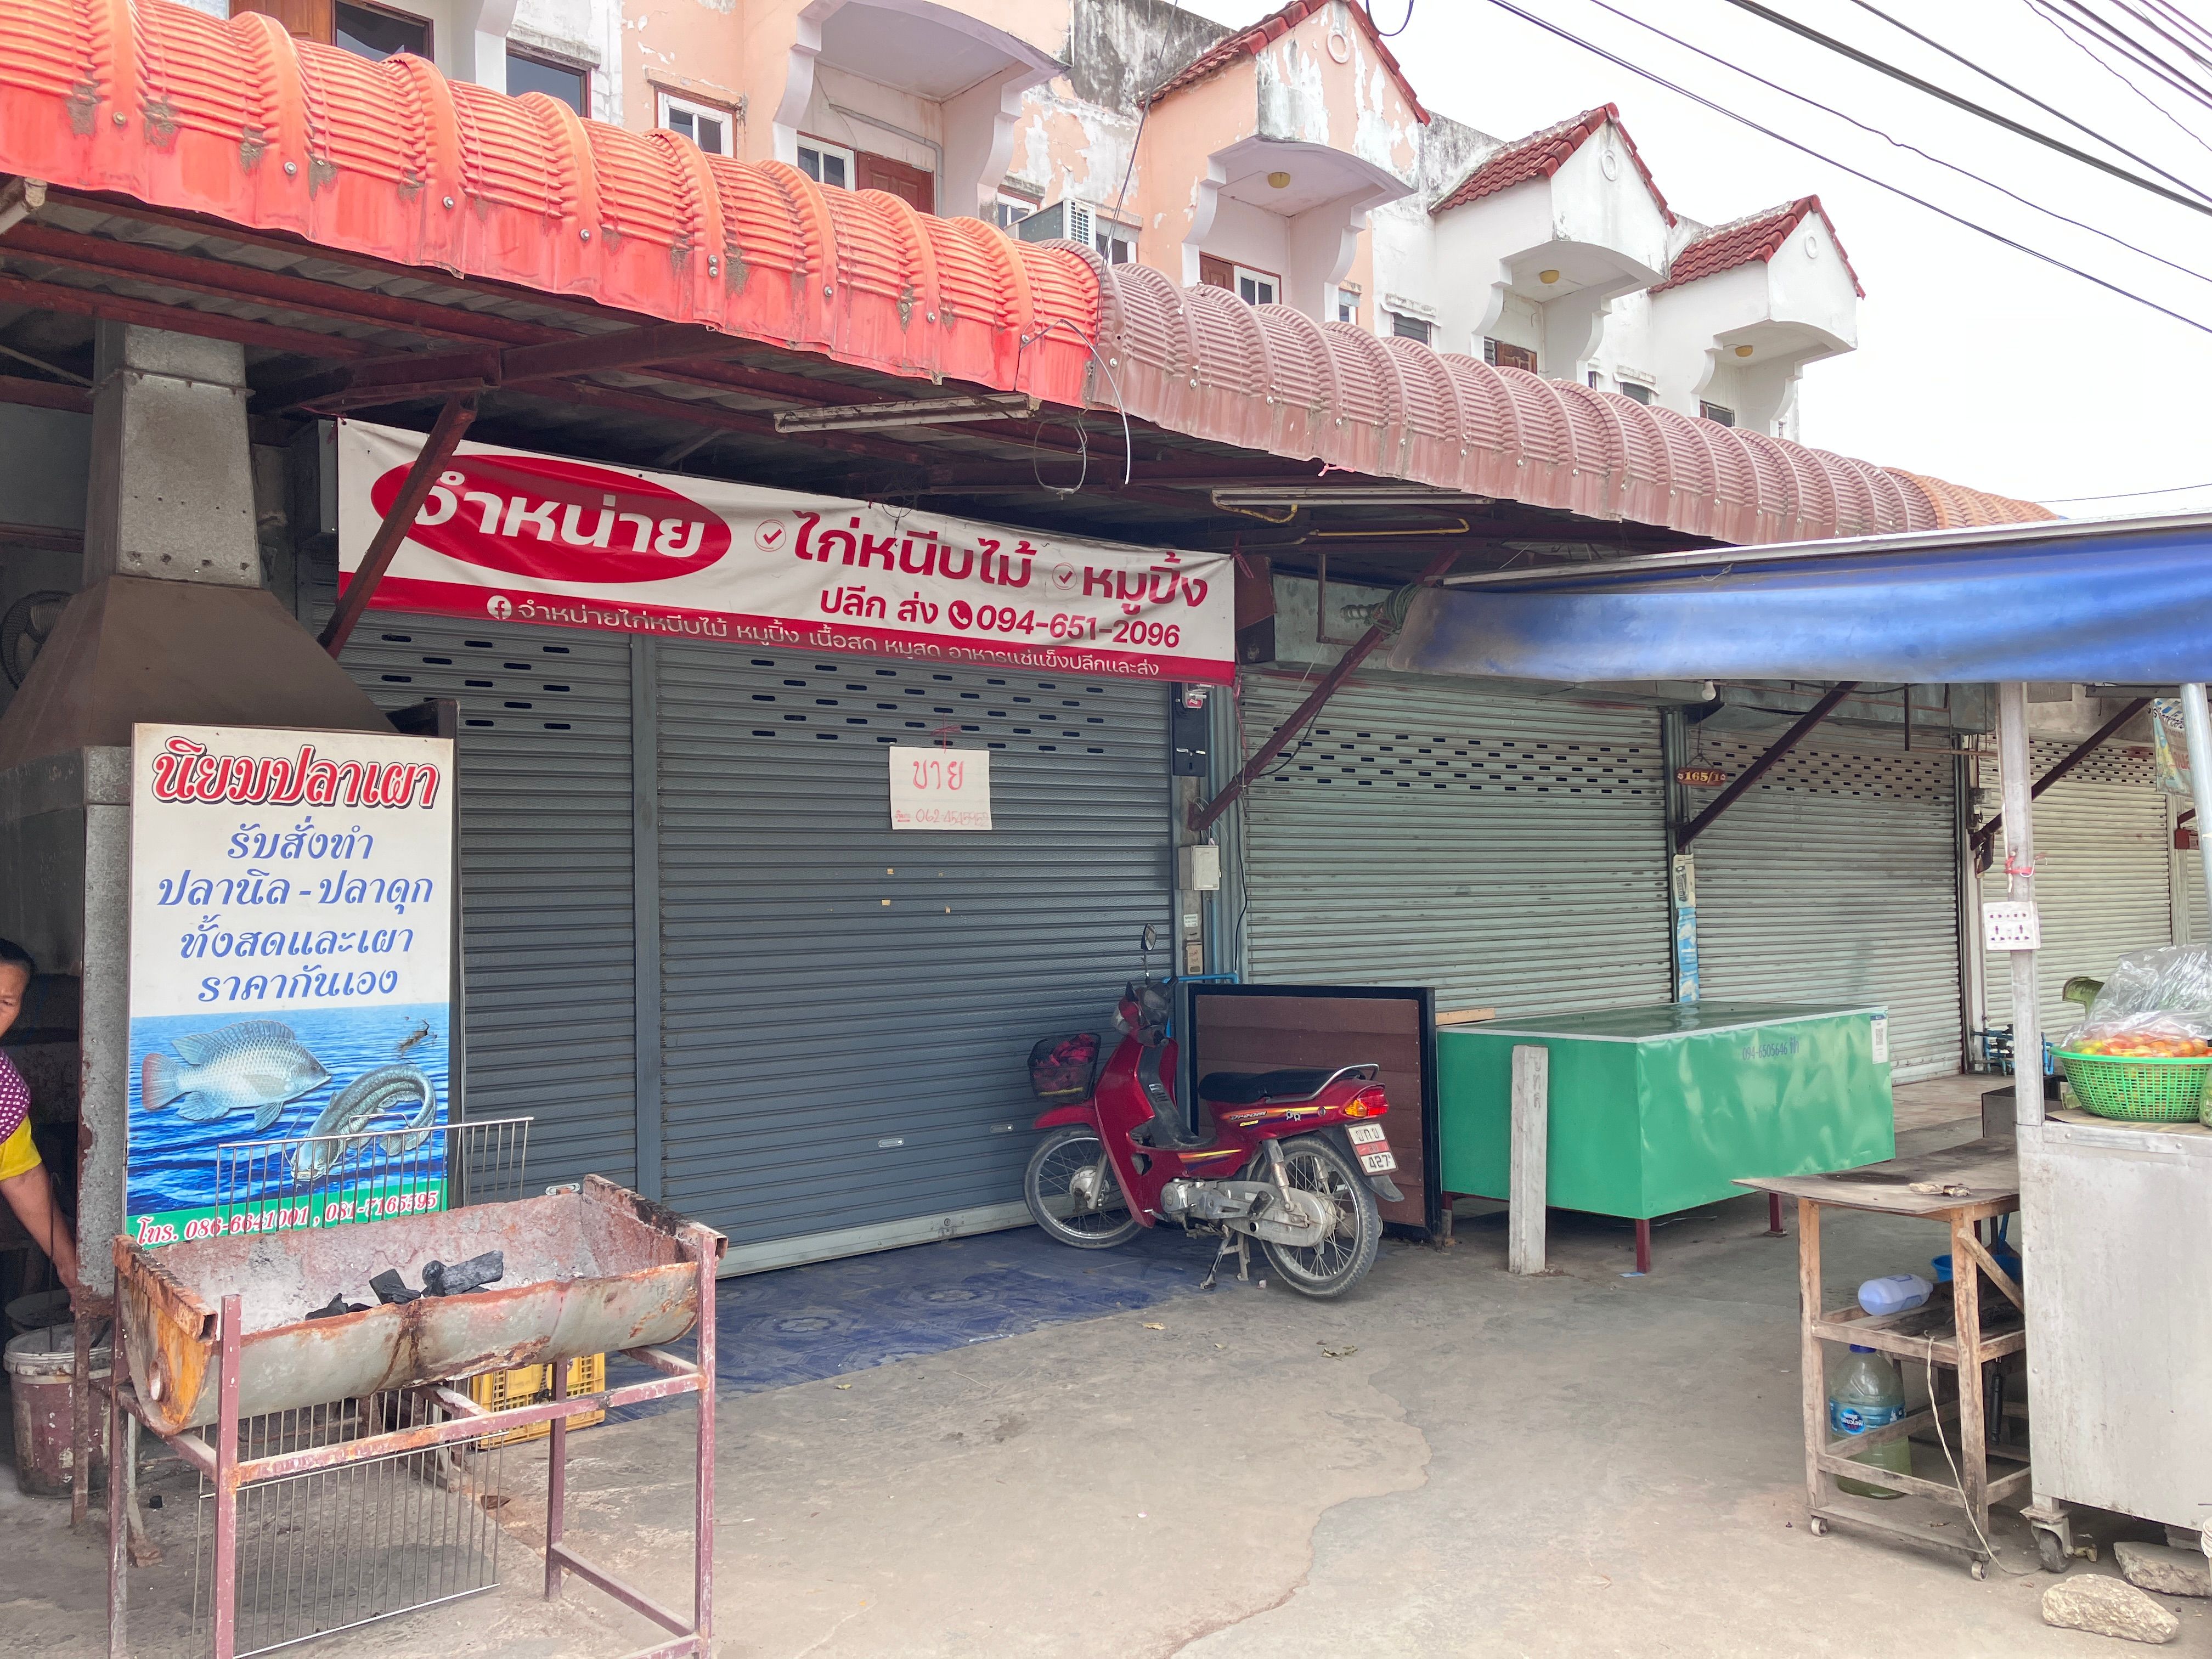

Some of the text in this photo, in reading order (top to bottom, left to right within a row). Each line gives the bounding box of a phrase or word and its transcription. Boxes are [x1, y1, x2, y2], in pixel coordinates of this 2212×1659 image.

[415, 471, 704, 557] จำหน่าย
[793, 510, 1208, 616] ไก่หนีบไม้ หมูปิ้ง
[820, 585, 1181, 649] ปลีก ส่ง 094-651-2096
[152, 736, 441, 810] นิยมปลาเผา
[912, 759, 964, 791] ขาย
[1684, 770, 1720, 783] 165/1
[227, 815, 374, 860] รับสั่งทำ
[180, 913, 414, 958] ทั้งสดและเผา
[198, 963, 398, 1002] ราคากันเอง
[1369, 1154, 1389, 1169] 427
[137, 1216, 179, 1246] โทร.
